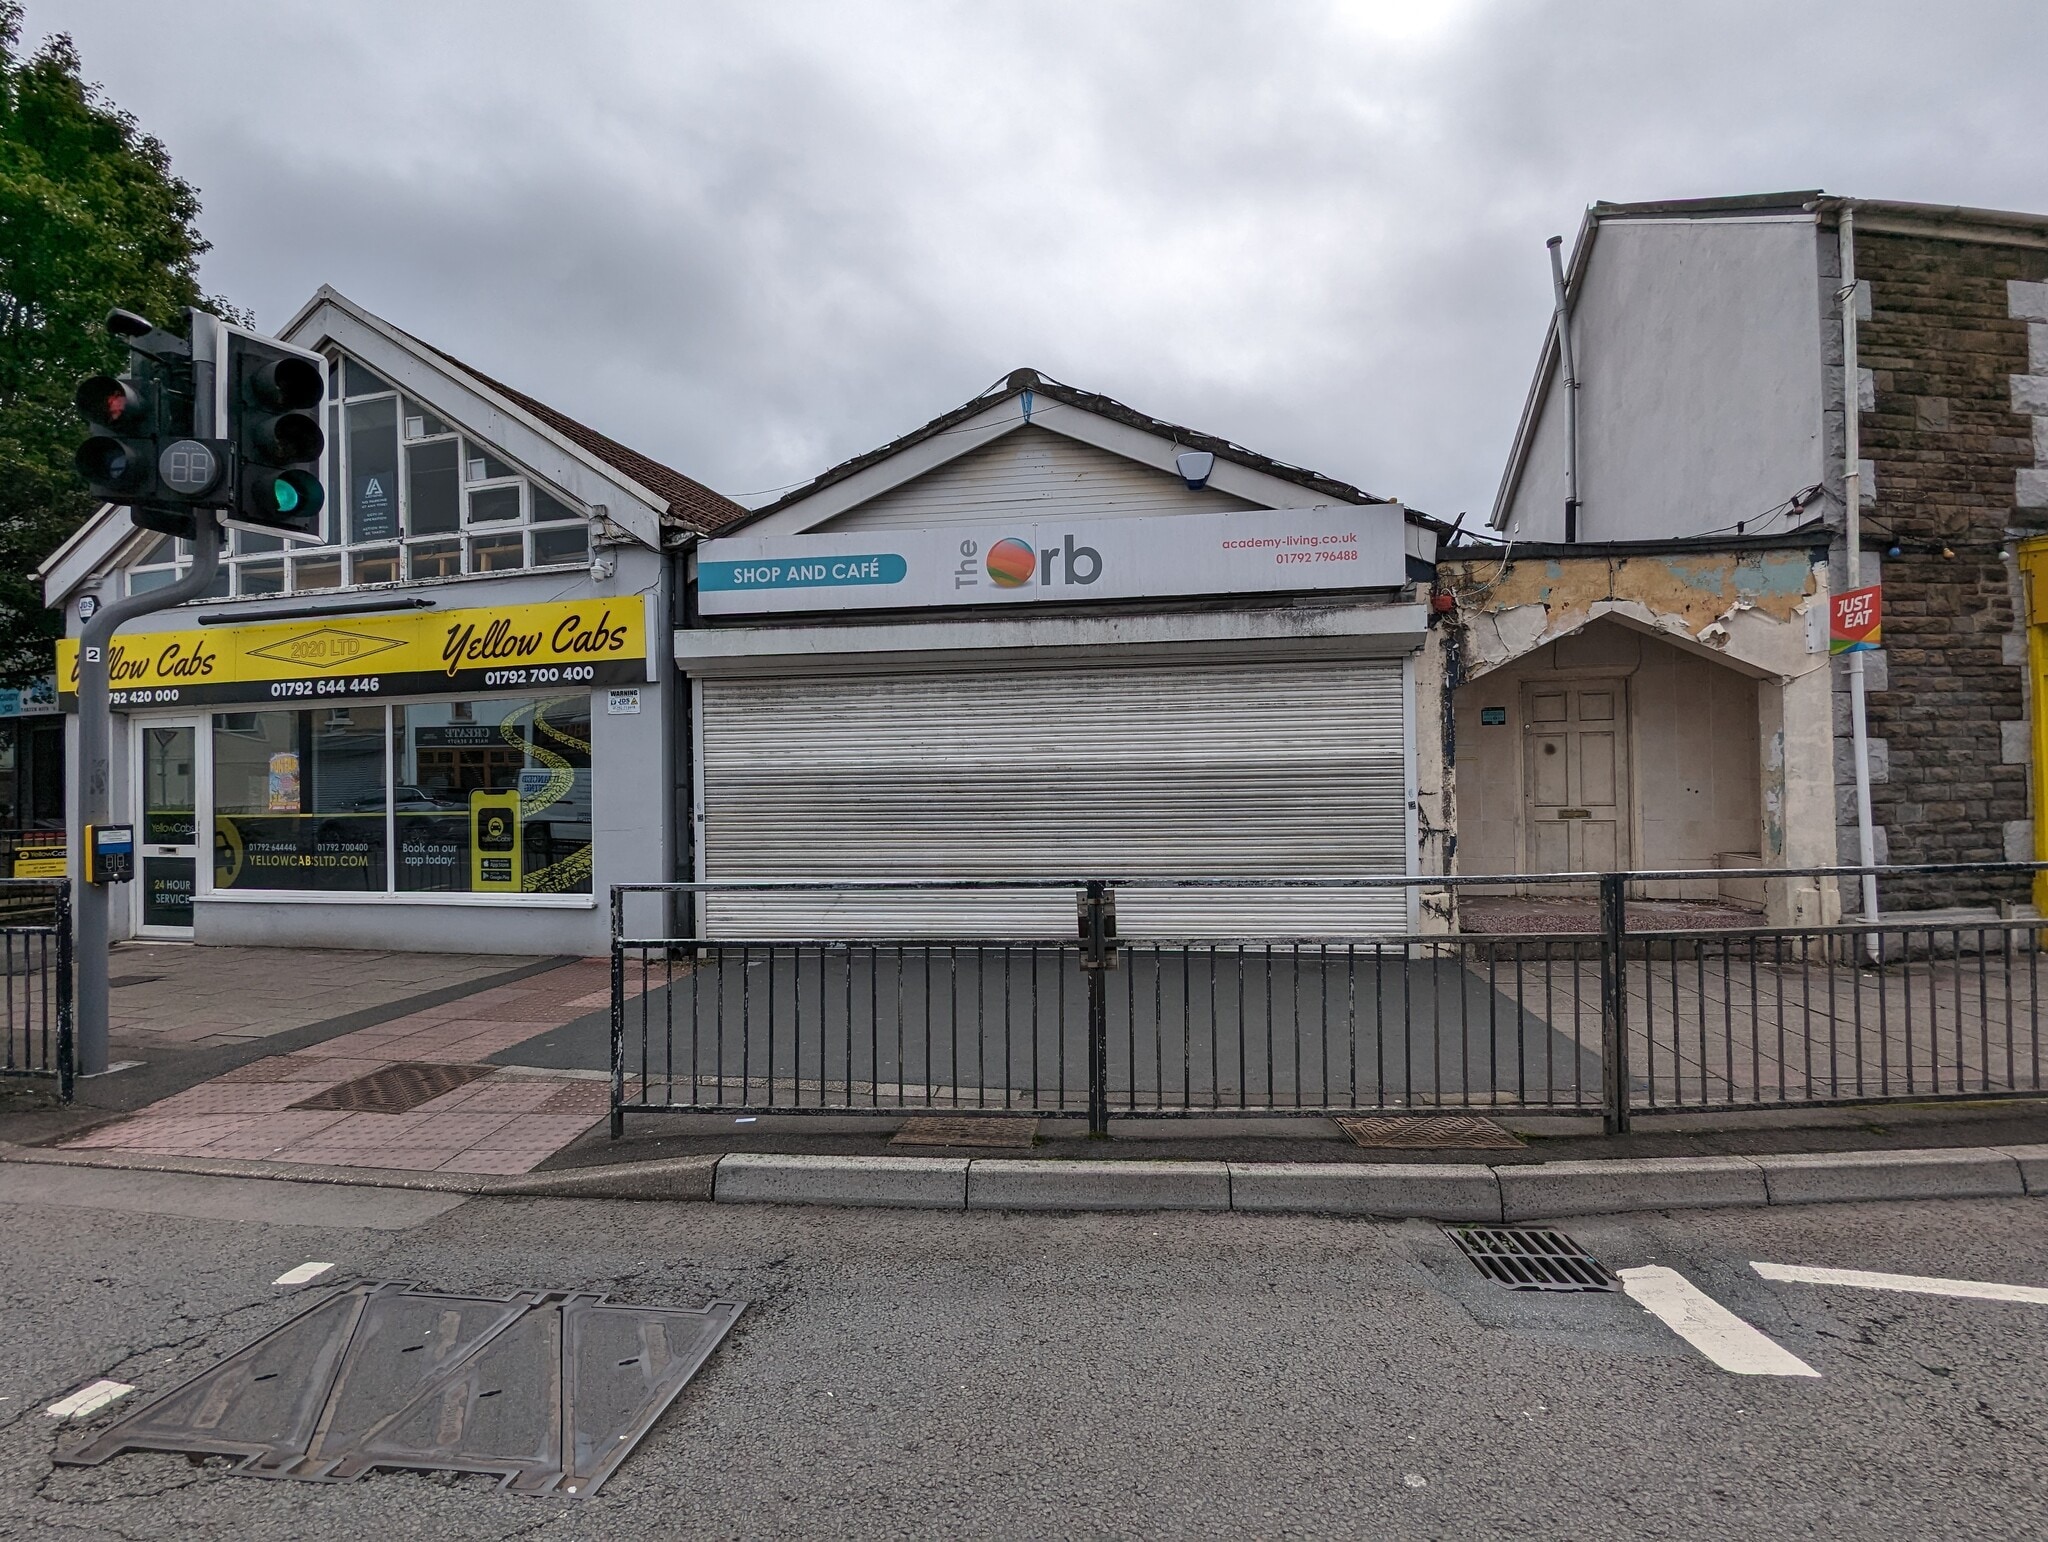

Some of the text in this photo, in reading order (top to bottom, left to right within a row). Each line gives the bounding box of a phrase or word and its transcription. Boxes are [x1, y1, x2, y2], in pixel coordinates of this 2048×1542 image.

[1222, 533, 1357, 549] academy-living.co.uk
[954, 539, 978, 590] The
[1276, 550, 1358, 564] 01792 796488
[733, 558, 879, 584] SHOP AND CAFÉ
[1837, 593, 1873, 617] JUST
[1844, 609, 1873, 629] EAT
[291, 638, 360, 659] 2020 LTD
[442, 610, 628, 677] Yellow Cabs
[88, 649, 99, 660] 2
[71, 640, 216, 698] llow Cabs
[485, 665, 594, 685] 01792 700 400
[271, 677, 380, 697] 01792 644 446
[109, 689, 179, 705] 792 420 000
[151, 823, 195, 833] YellowCabs
[31, 850, 67, 858] YellowCab
[249, 843, 297, 851] 01792 644446
[317, 843, 368, 852] 01792 700400
[402, 843, 458, 853] Book on our
[405, 855, 456, 867] app today:
[154, 880, 191, 890] 24 HOUR
[155, 893, 190, 904] SERVICE
